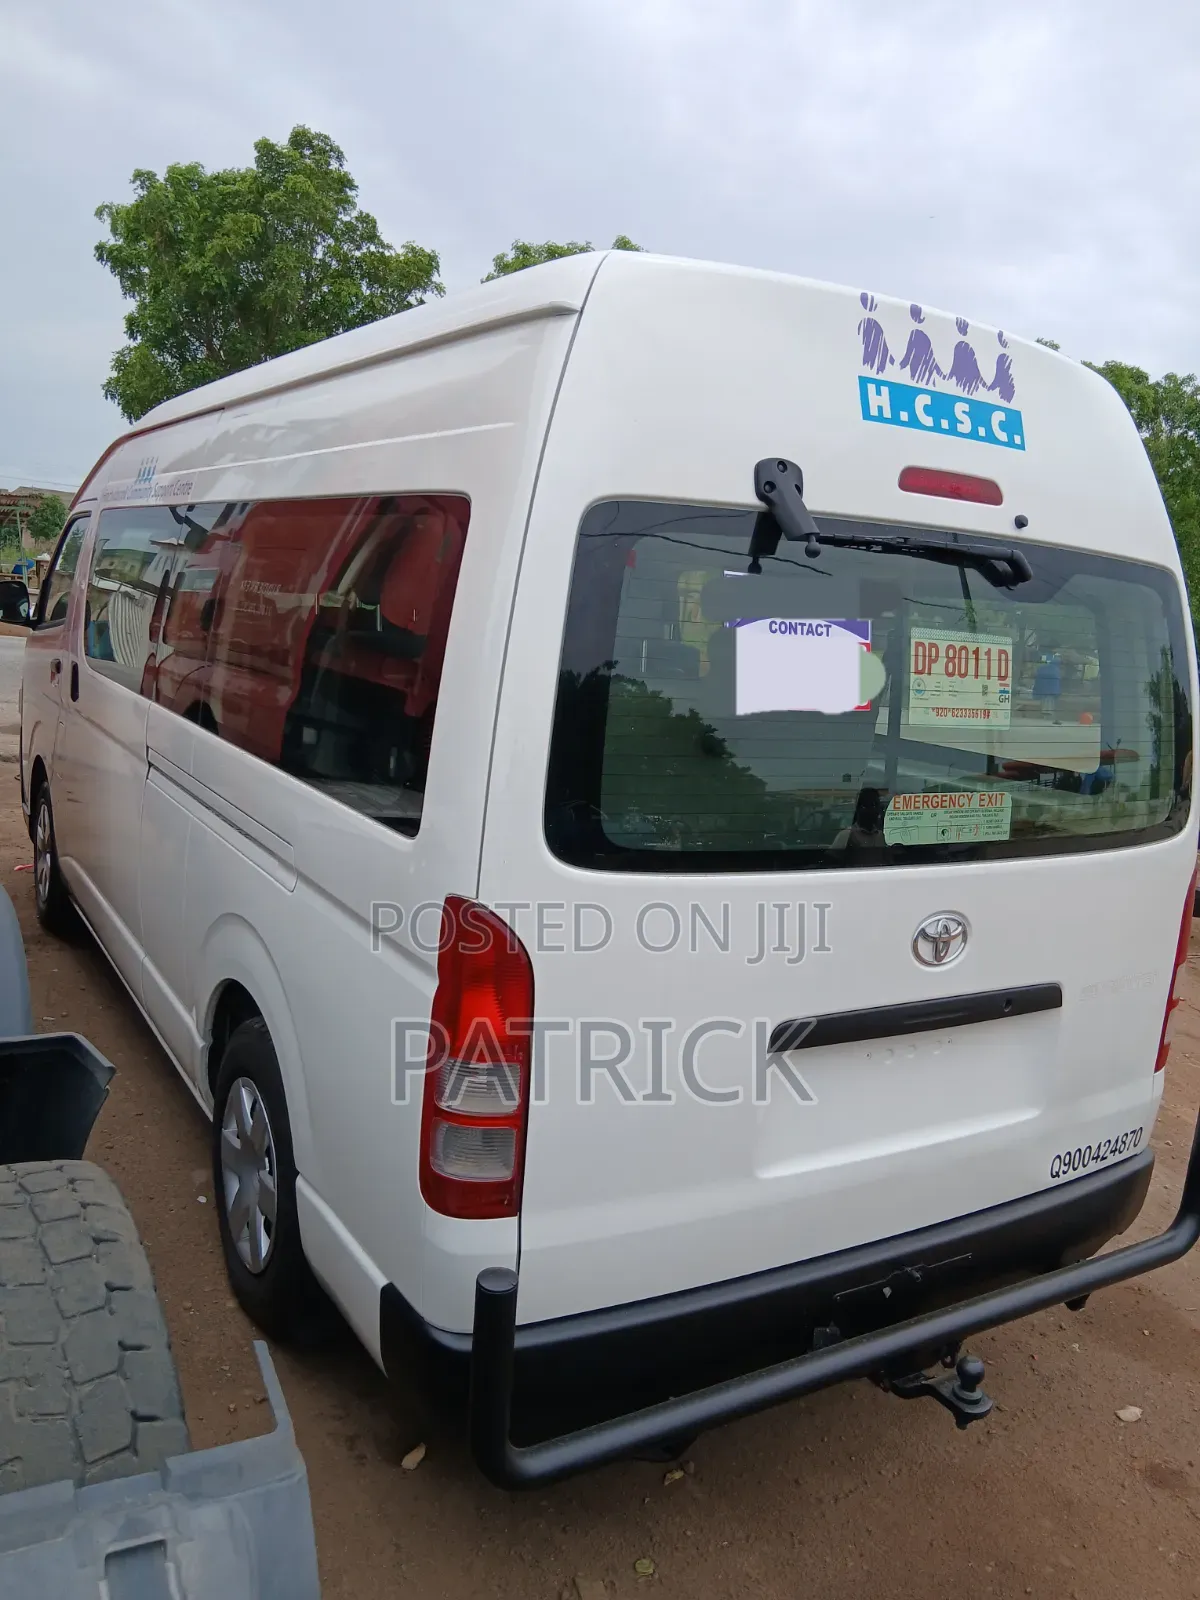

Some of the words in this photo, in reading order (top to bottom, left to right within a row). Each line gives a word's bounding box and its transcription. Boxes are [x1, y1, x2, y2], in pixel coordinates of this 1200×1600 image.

[867, 383, 1022, 445] H.C.S.C.
[768, 620, 832, 638] CONTACT
[914, 641, 940, 676] DP
[998, 694, 1010, 704] GH
[892, 793, 974, 810] EMERGENCY
[978, 792, 1006, 807] EXIT
[1049, 1126, 1144, 1180] Q900424870
